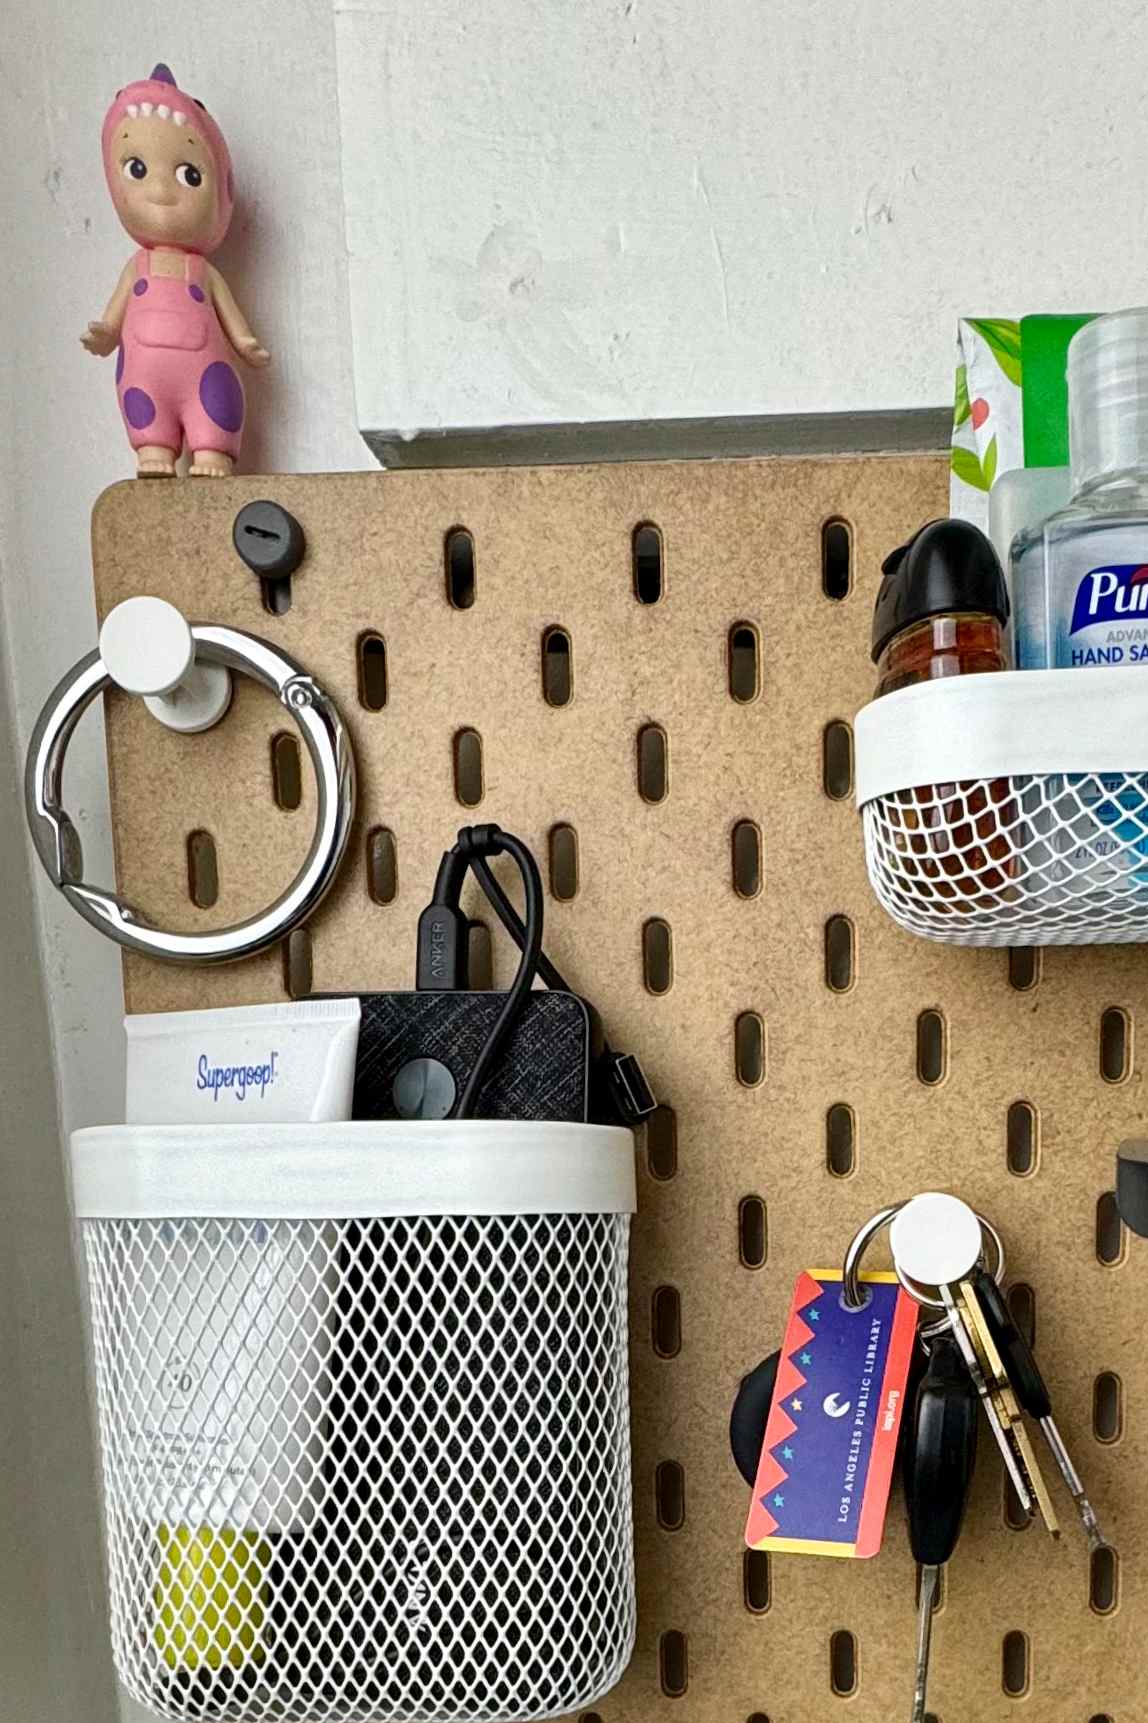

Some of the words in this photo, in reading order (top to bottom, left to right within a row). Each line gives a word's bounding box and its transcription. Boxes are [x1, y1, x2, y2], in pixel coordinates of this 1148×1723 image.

[1071, 646, 1124, 667] HAND
[431, 921, 446, 978] ANKER
[197, 1051, 274, 1102] Supergoop!
[837, 1496, 851, 1523] LOS
[844, 1430, 862, 1492] ANGELES
[854, 1378, 871, 1425] PUBLIC
[863, 1318, 881, 1373] LIBRARY
[881, 1390, 900, 1431] lapl.org
